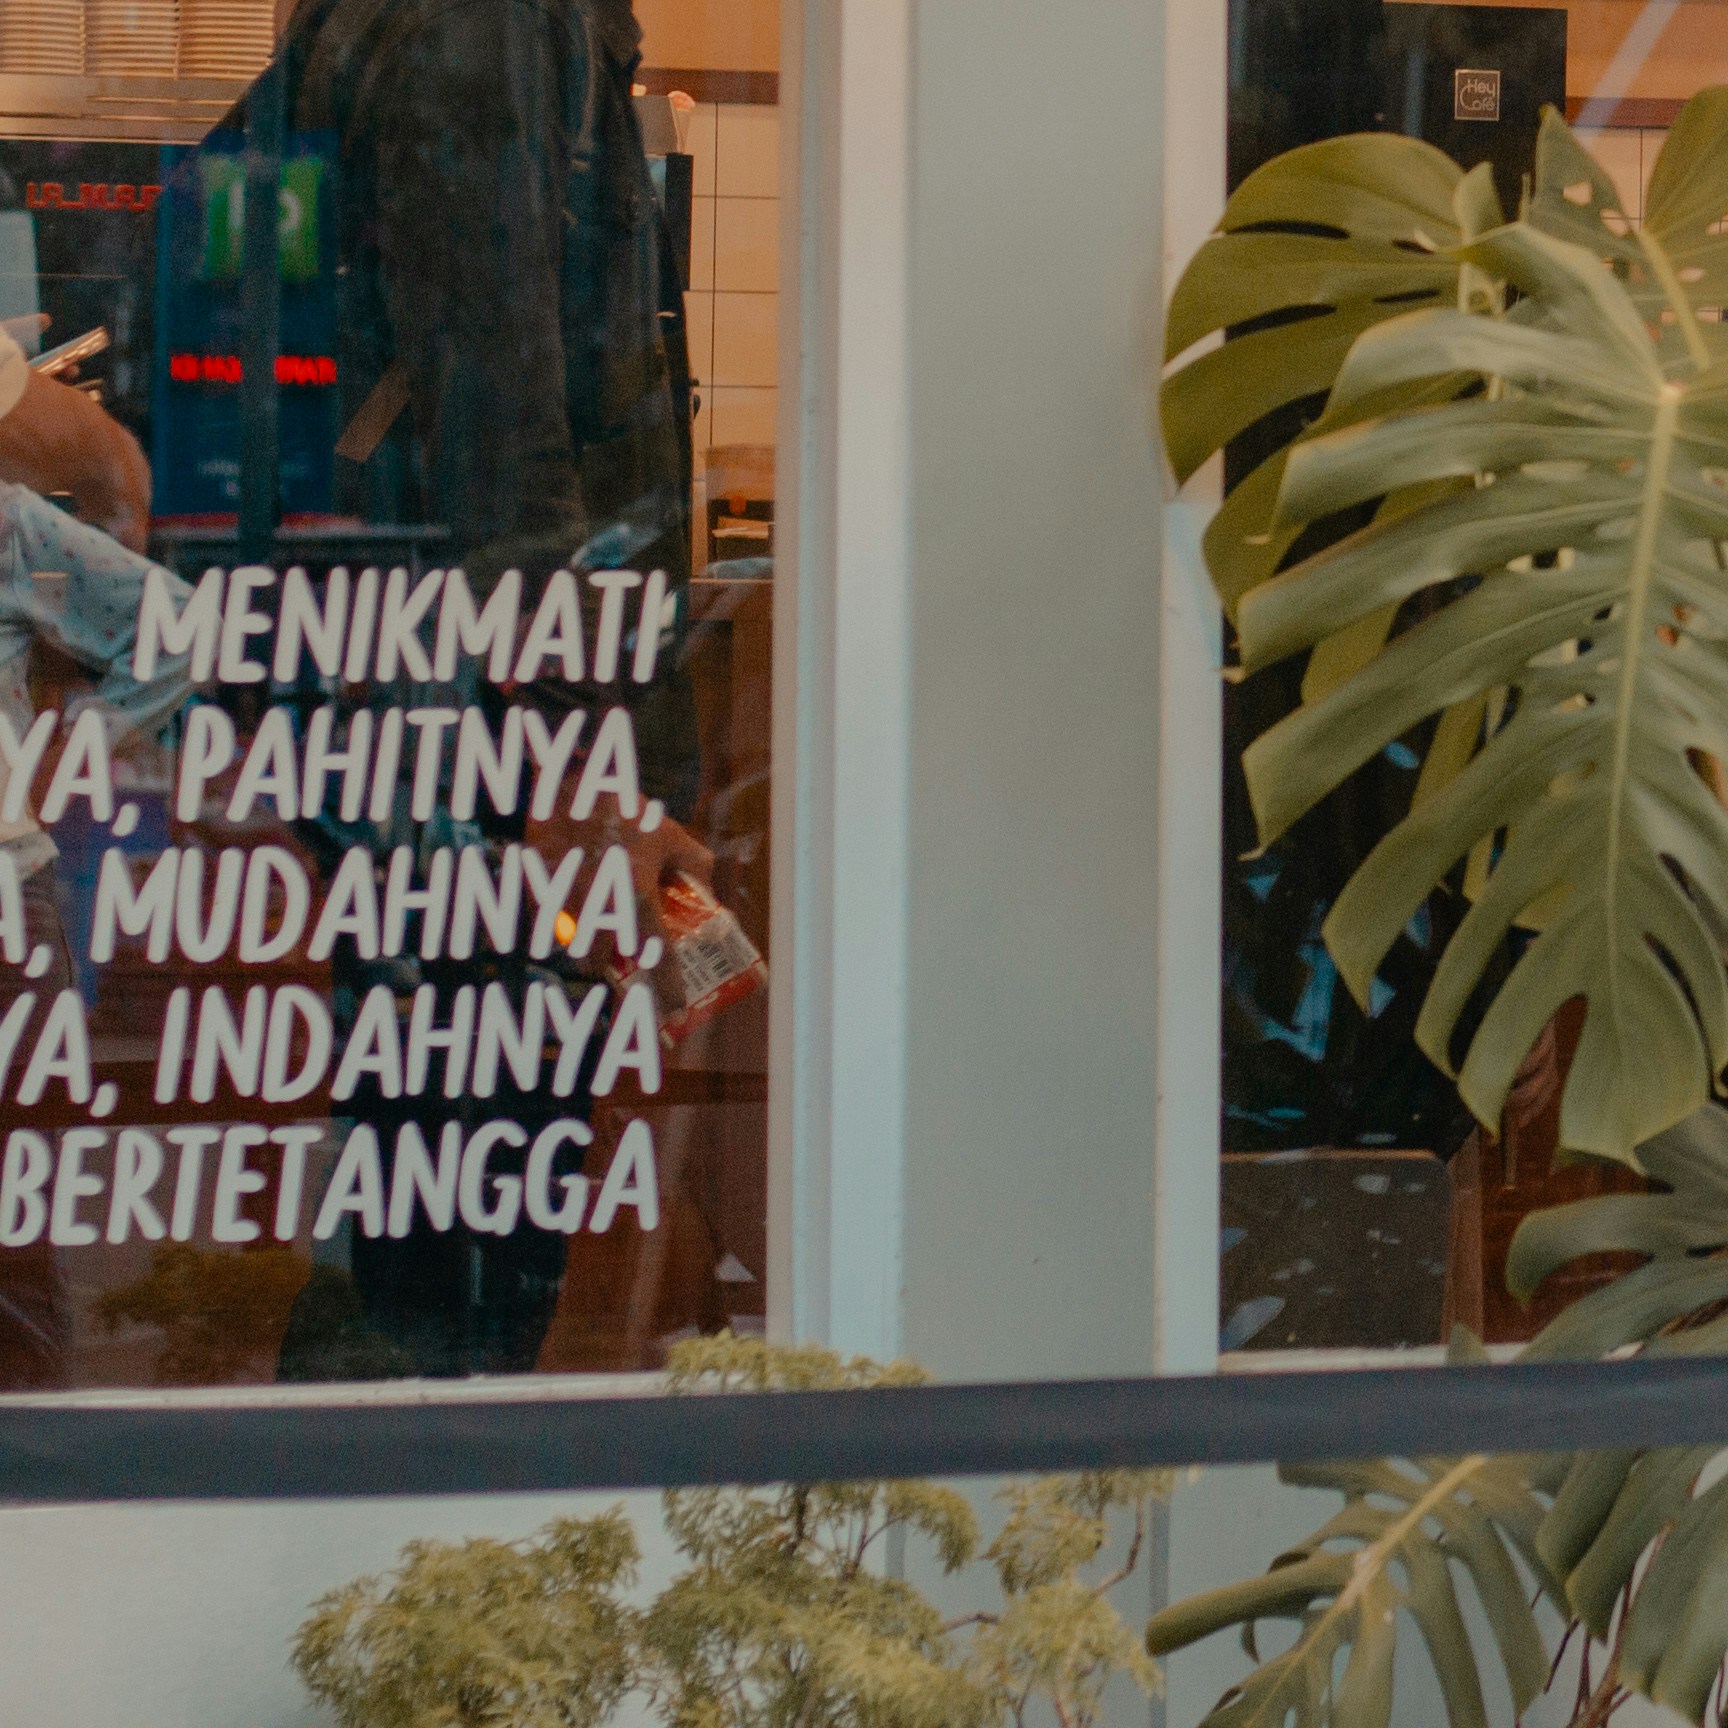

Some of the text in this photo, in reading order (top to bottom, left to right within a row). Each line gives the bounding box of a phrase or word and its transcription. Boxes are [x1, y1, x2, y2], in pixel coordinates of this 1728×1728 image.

[1468, 78, 1495, 97] Hey
[133, 566, 666, 683] MENIKMATI
[176, 704, 665, 832] PAHITNYA,
[90, 845, 662, 970] MUDAHNYA,
[155, 982, 661, 1104] INDAHNYA
[0, 1118, 658, 1247] BERTETANGGA
